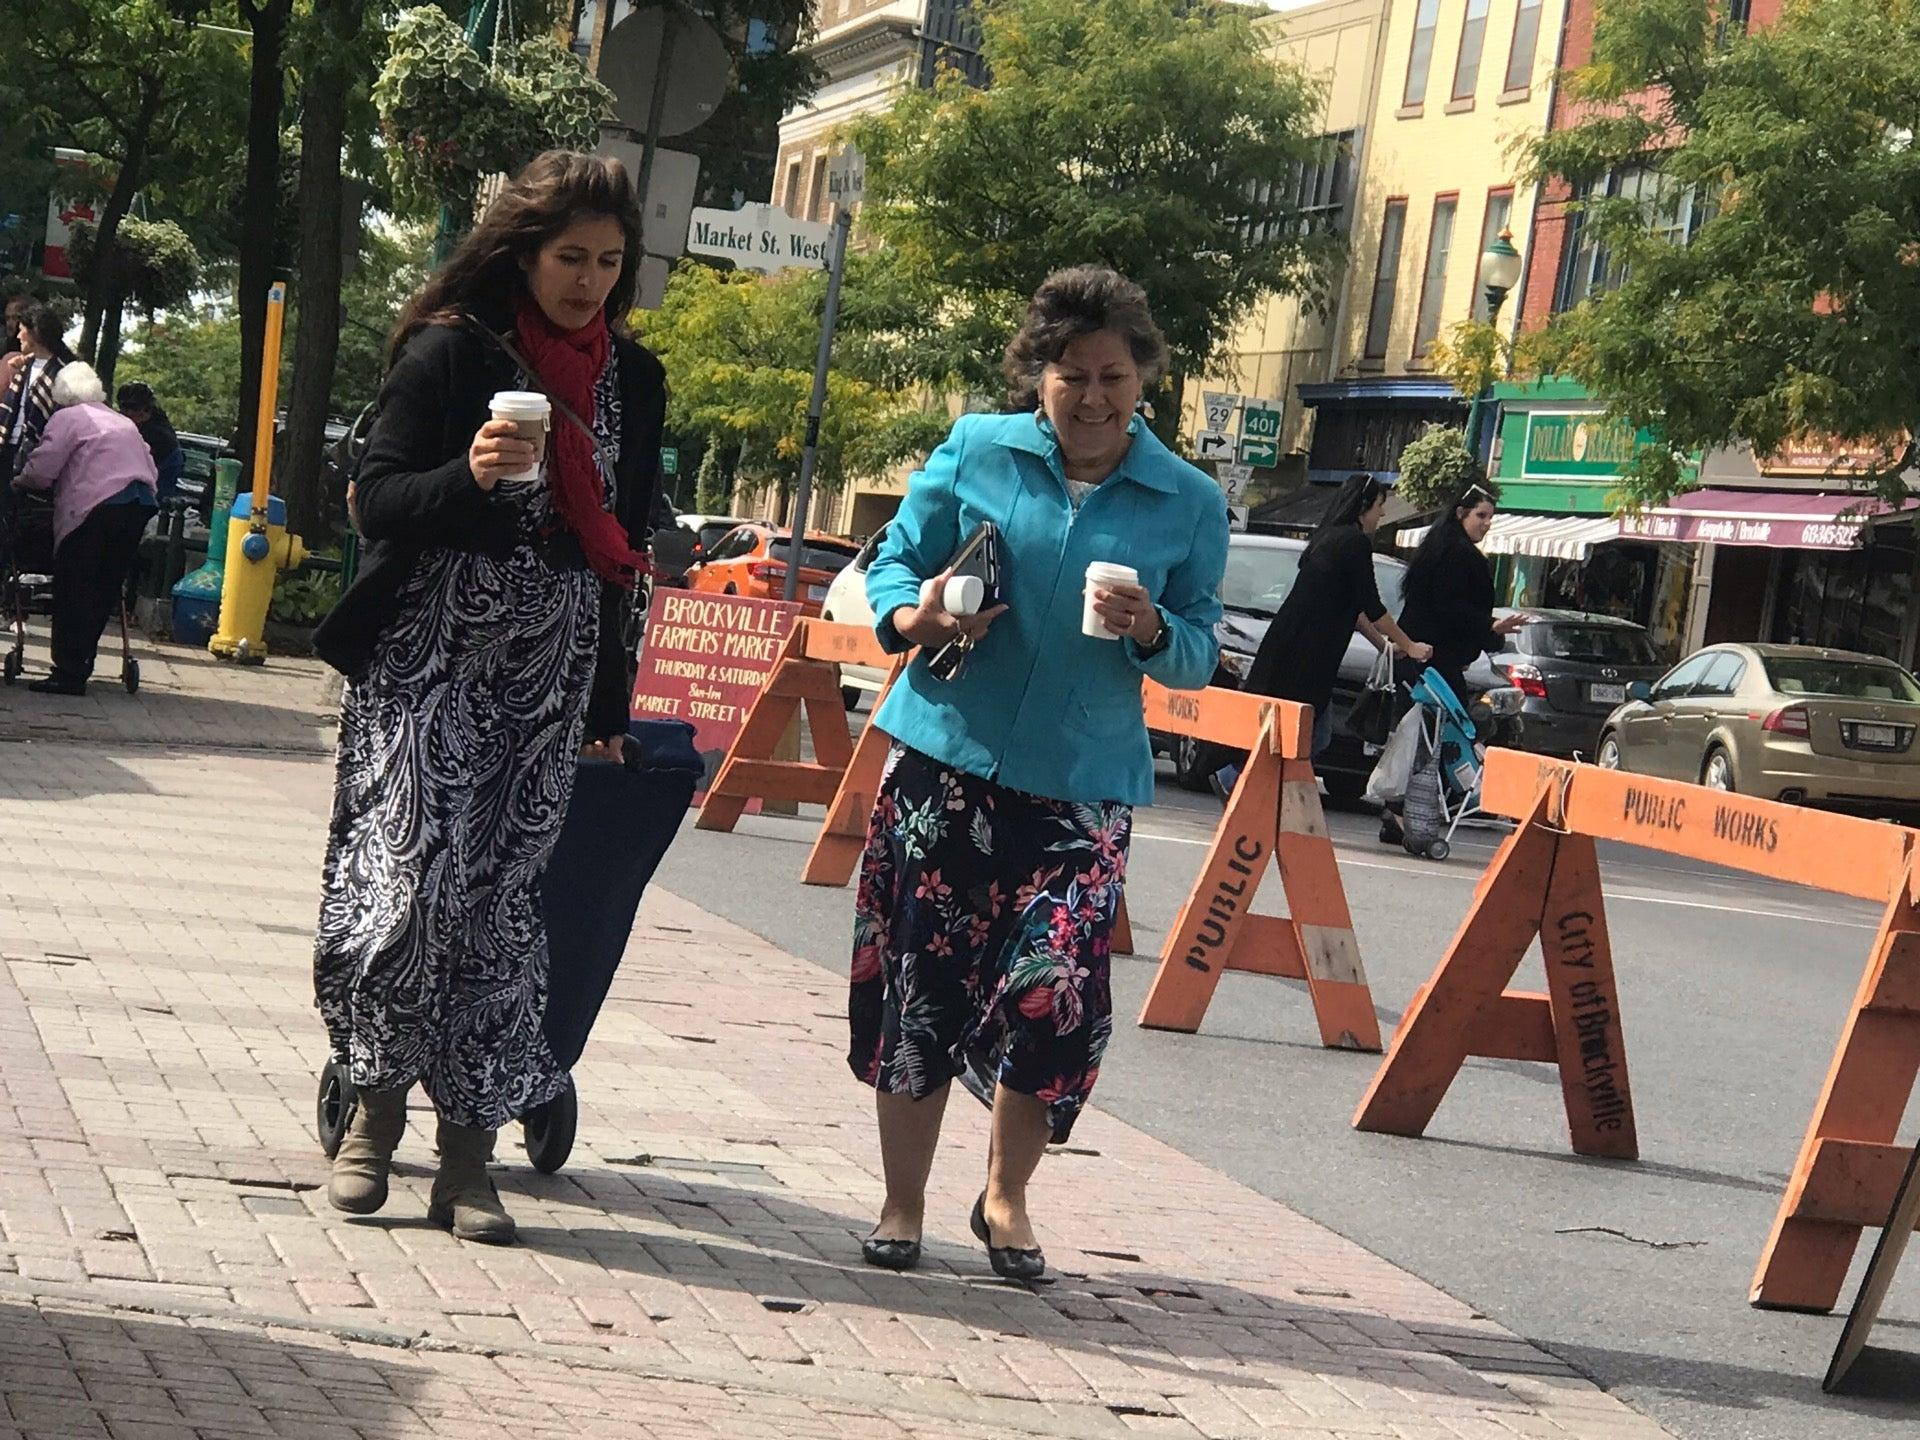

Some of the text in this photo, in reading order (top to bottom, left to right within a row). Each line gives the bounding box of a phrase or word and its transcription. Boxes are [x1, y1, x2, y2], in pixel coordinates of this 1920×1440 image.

[693, 221, 826, 260] Market St. West
[1209, 407, 1229, 422] 29
[1248, 417, 1275, 434] 401
[1227, 479, 1237, 494] 2
[662, 596, 787, 636] BROCKVILLE
[650, 624, 787, 662] FARMERS' MARKET
[654, 658, 770, 687] THURSDAY & SATURDA
[634, 693, 682, 715] MARKET
[688, 700, 737, 722] STREET
[1168, 692, 1199, 722] WORKS
[1624, 787, 1779, 853] PUBLIC WORKS
[1185, 834, 1262, 973] PUBLIC
[1558, 911, 1595, 968] City
